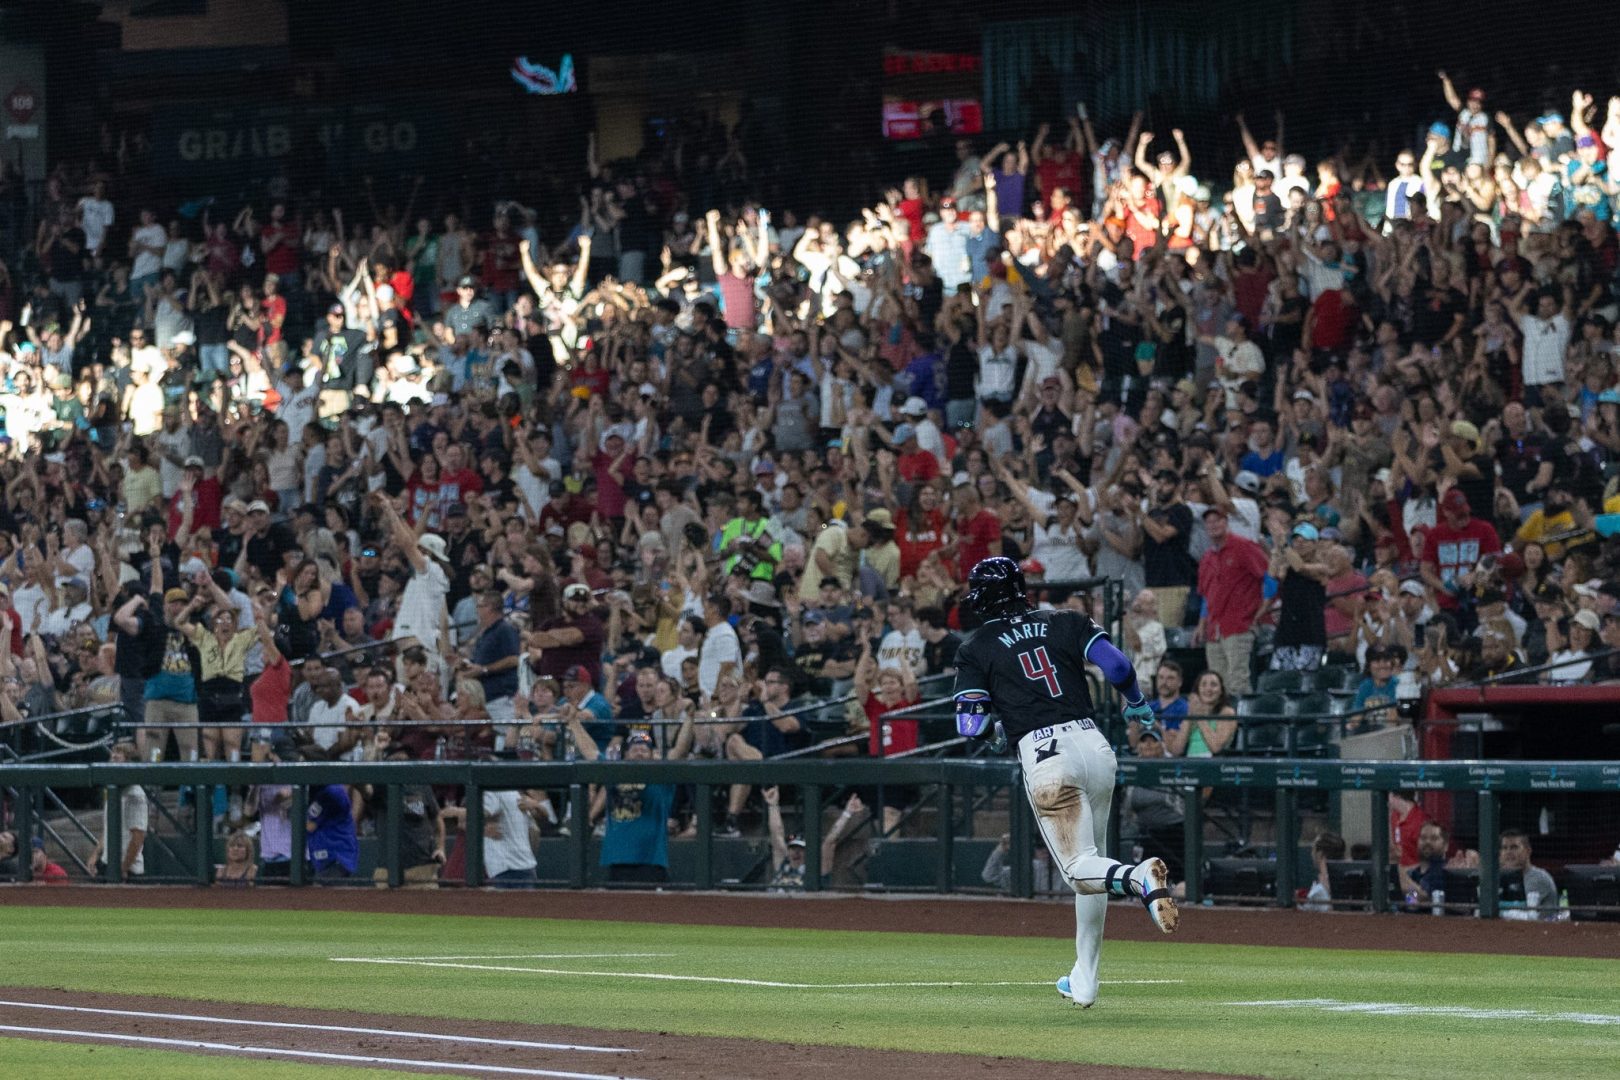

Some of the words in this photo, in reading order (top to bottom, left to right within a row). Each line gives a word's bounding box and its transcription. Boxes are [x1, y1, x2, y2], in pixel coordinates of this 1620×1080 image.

[178, 125, 293, 161] GRAB
[363, 121, 417, 154] GO
[998, 622, 1048, 648] MARTE
[1018, 645, 1063, 698] 4
